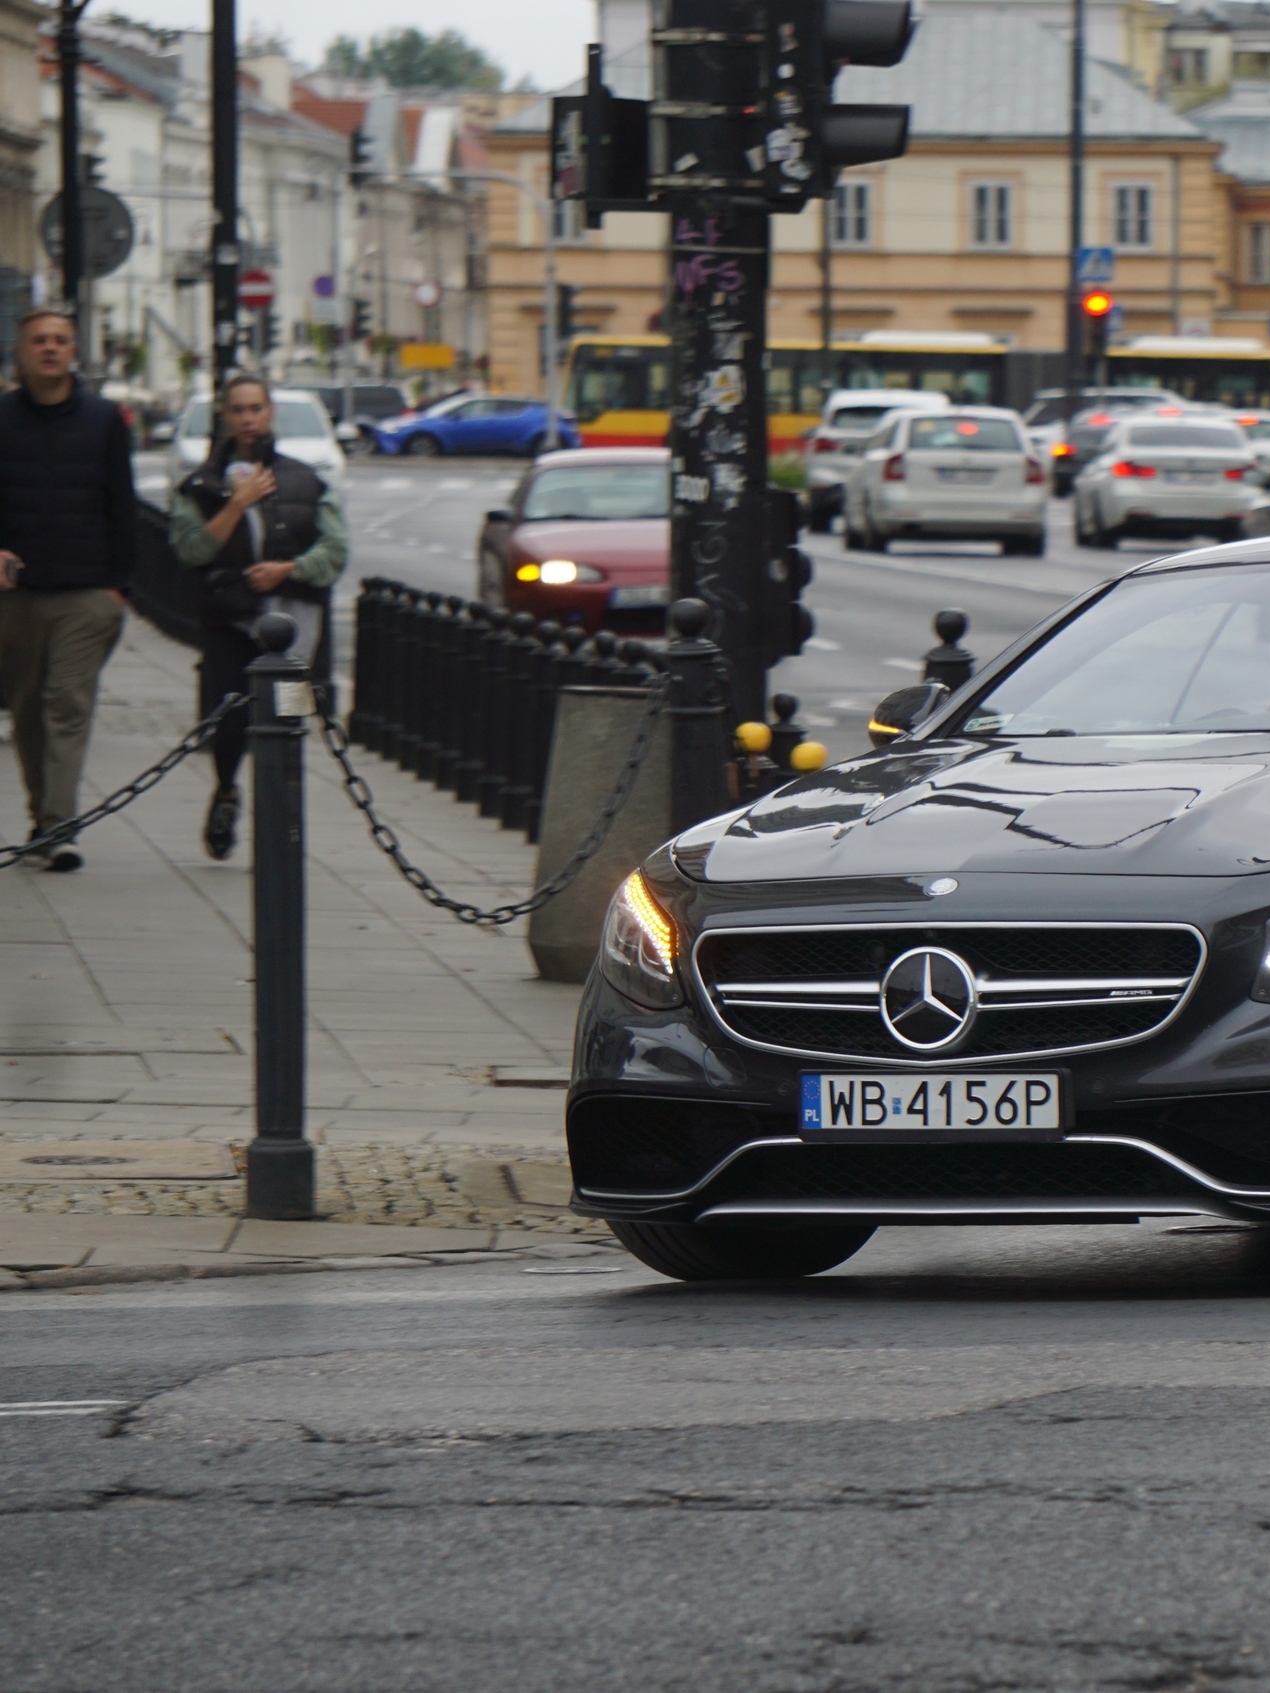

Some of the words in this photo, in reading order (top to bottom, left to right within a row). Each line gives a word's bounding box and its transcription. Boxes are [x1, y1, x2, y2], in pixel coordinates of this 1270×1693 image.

[805, 1110, 819, 1122] PL
[828, 1080, 888, 1126] WB
[907, 1080, 1051, 1126] 4156P
